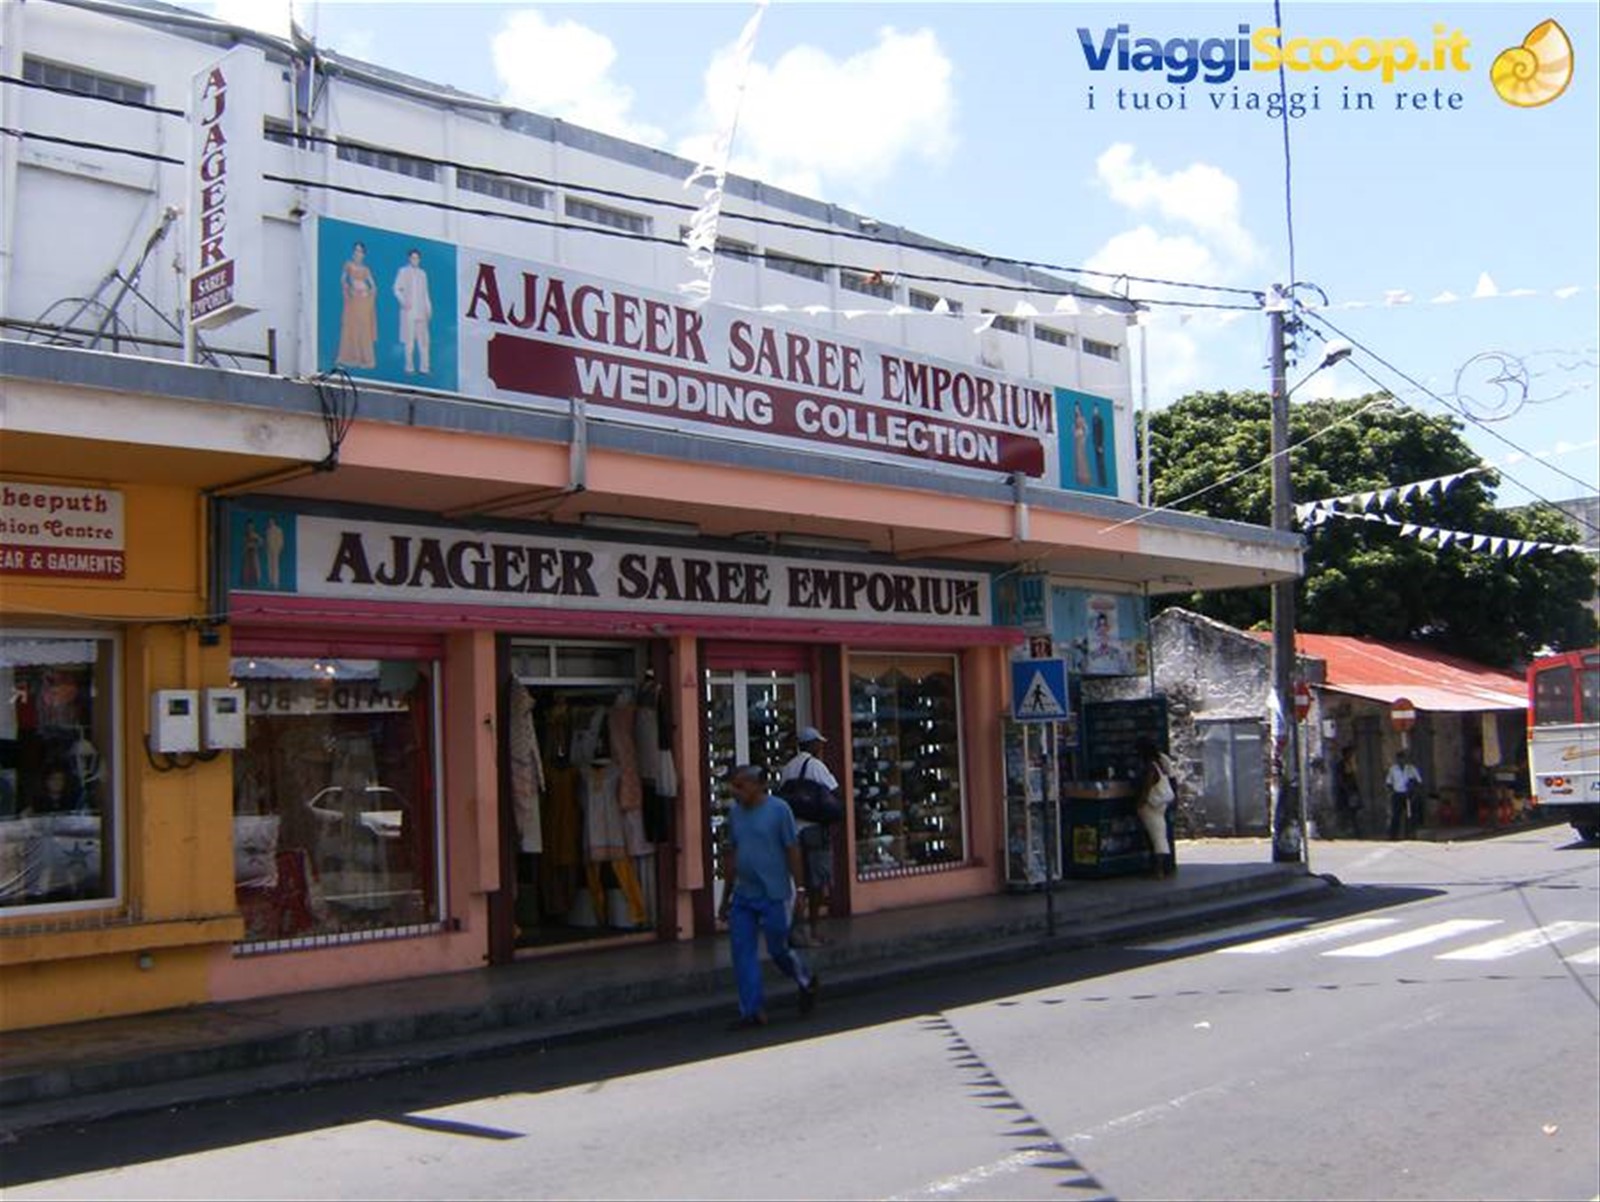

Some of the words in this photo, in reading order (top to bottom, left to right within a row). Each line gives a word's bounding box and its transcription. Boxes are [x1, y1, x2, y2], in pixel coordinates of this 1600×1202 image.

[201, 67, 227, 271] AJAGEER
[466, 263, 708, 364] AJAGEER
[728, 320, 865, 396] SAREE
[880, 354, 1054, 434] EMPORIUM
[574, 356, 773, 425] WEDDING
[795, 398, 998, 464] COLLECTION
[31, 552, 42, 569] &
[47, 553, 122, 574] GARMENTS
[43, 519, 113, 539] Centre
[326, 531, 599, 597] AJAGEER
[617, 553, 770, 606] SAREE
[787, 566, 980, 616] EMPORIUM
